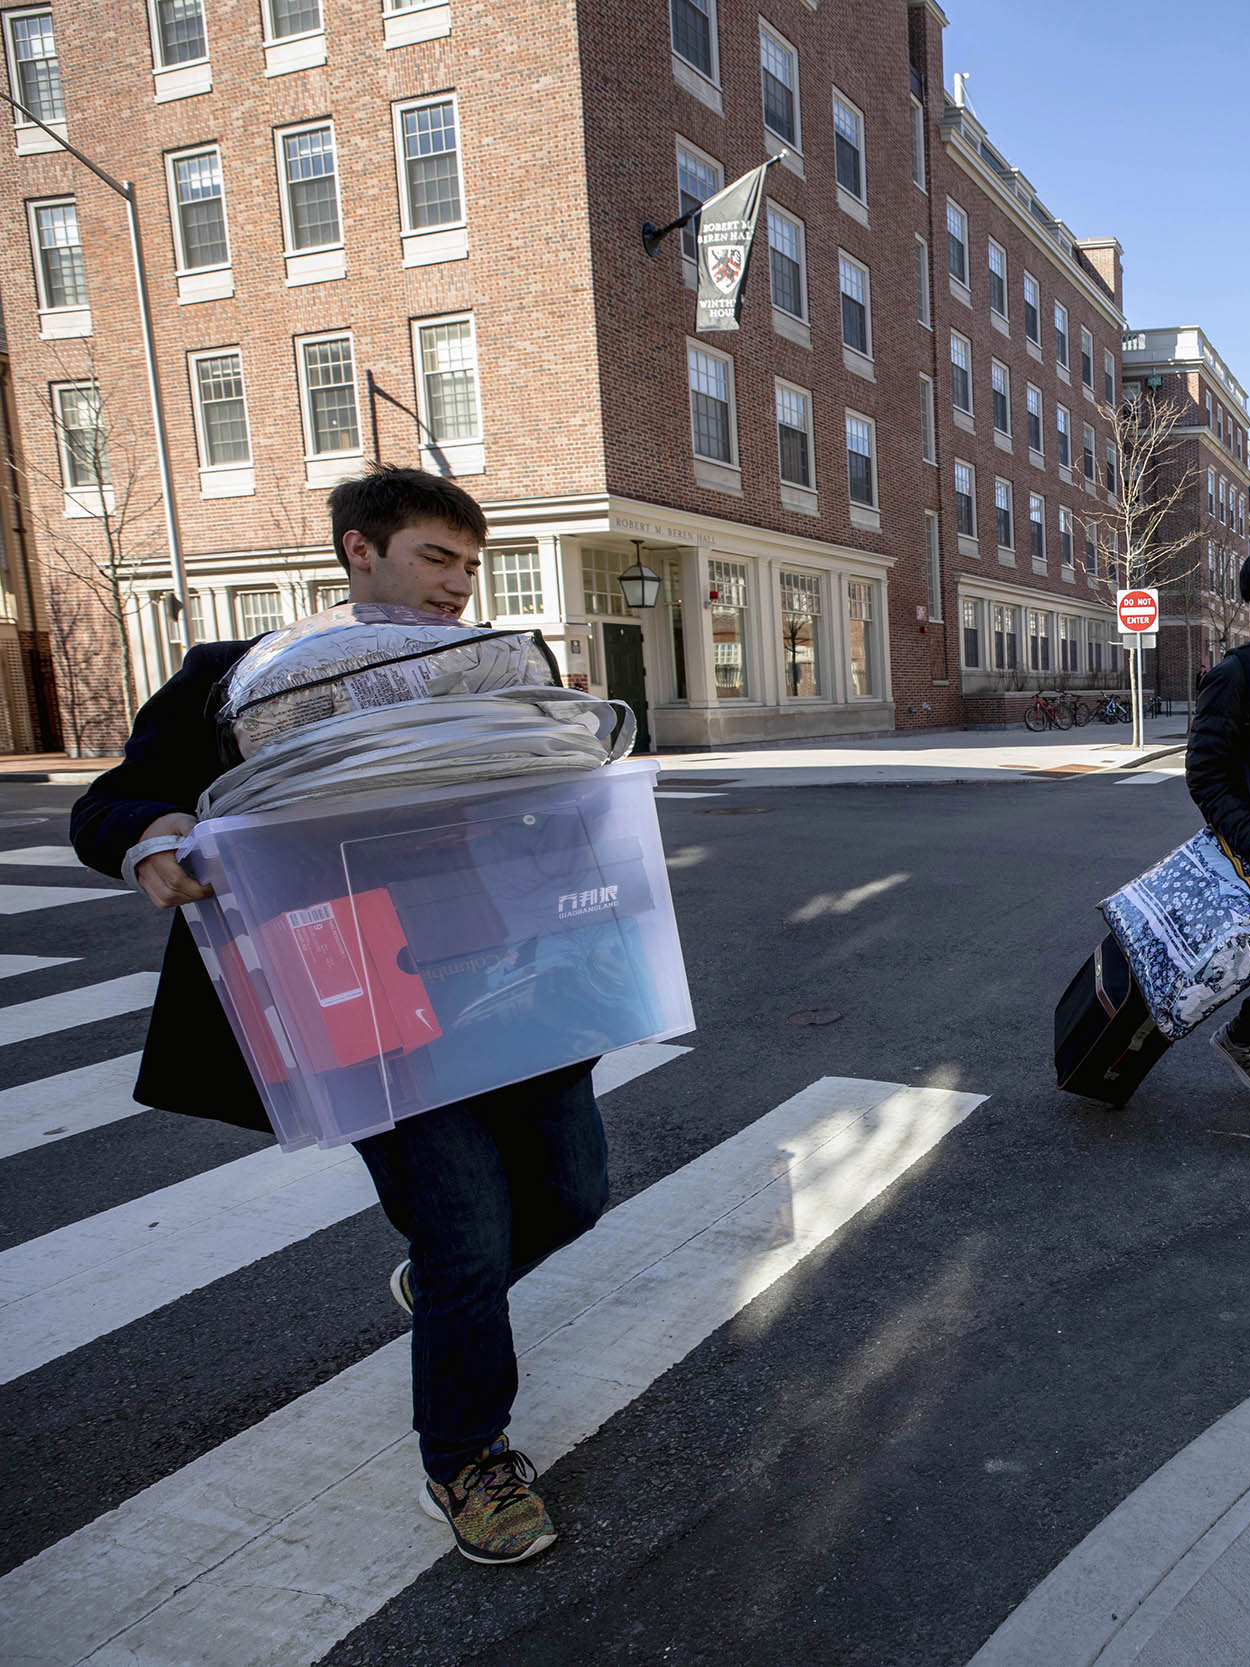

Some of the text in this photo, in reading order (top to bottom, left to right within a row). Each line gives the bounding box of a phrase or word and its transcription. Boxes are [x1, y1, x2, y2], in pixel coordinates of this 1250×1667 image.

[615, 518, 717, 545] ROBERT M. BEREN HALL
[1126, 616, 1150, 625] ENTER
